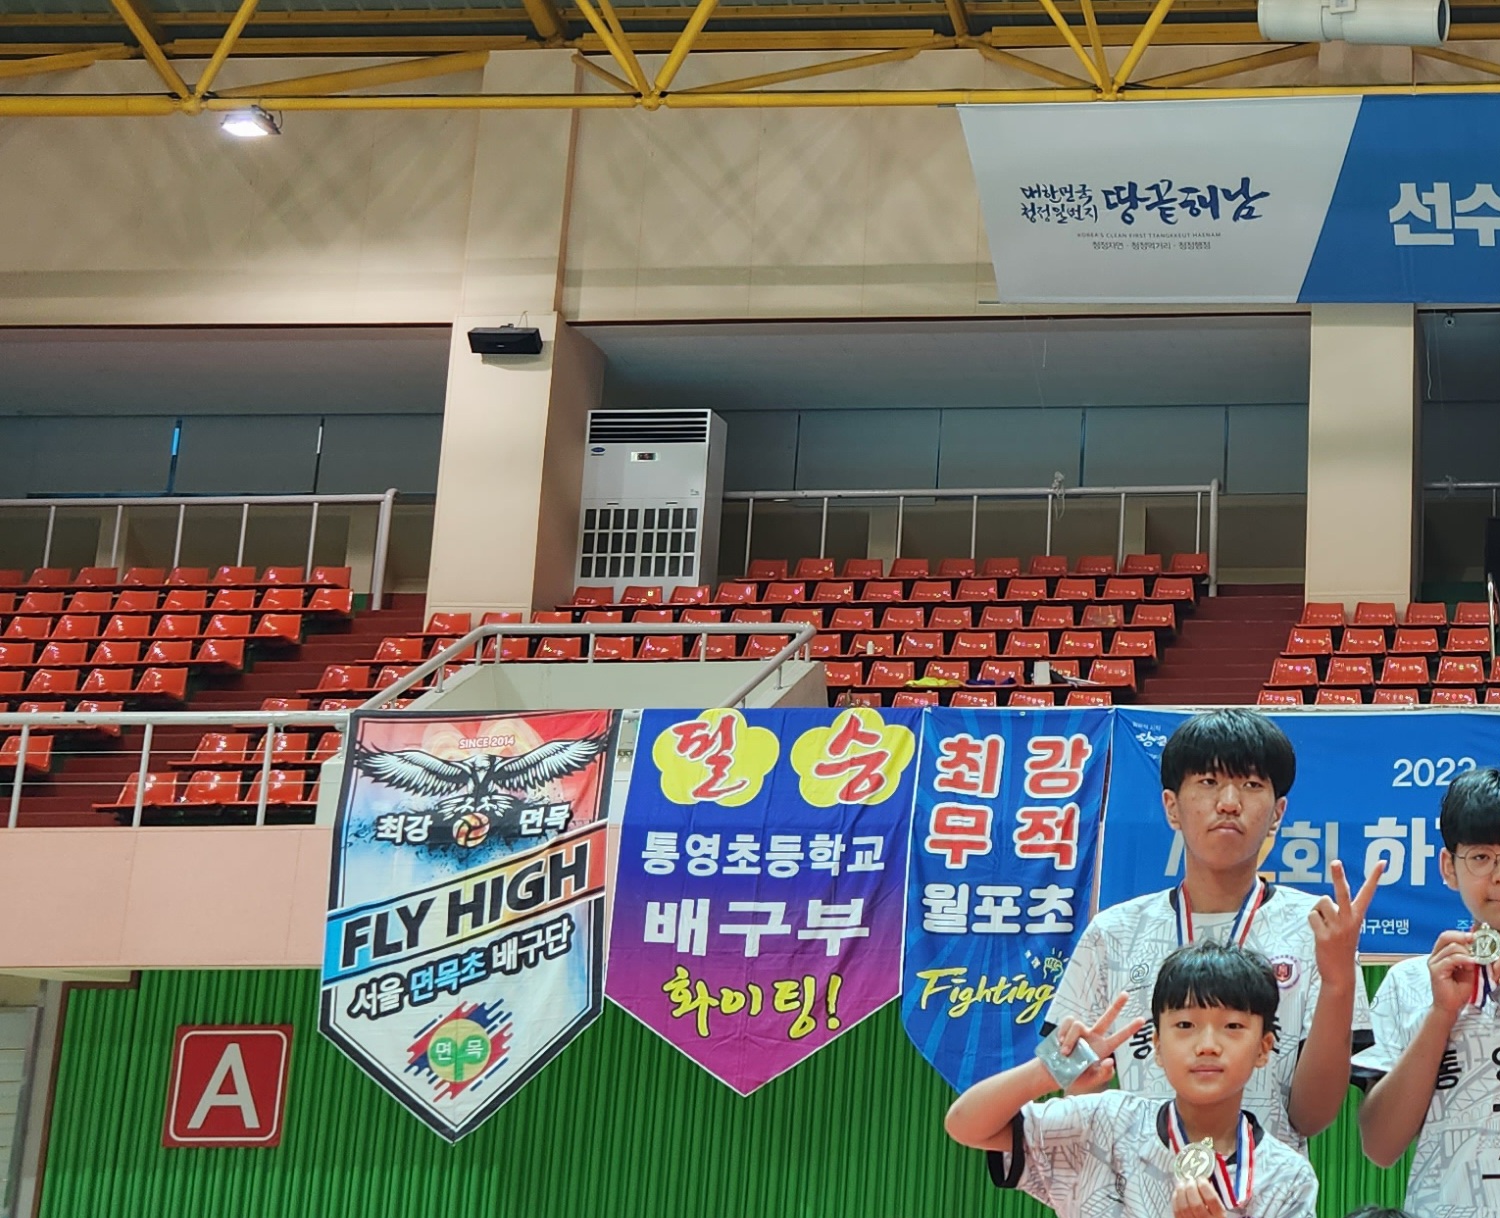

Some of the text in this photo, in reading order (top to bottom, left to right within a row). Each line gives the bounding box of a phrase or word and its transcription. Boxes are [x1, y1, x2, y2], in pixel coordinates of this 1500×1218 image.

[1020, 176, 1270, 225] 대한민국 땅끝해남
[459, 735, 516, 749] SINCE 2014
[376, 804, 571, 845] 최강 면목
[925, 801, 1081, 870] 무적
[641, 830, 886, 878] 통영초등학교
[338, 841, 592, 973] FLY HIGH
[643, 898, 870, 958] 배구부
[922, 882, 1076, 935] 월포초
[349, 919, 572, 1017] 서울 면목초 배구단
[915, 967, 1056, 1024] Fighting
[662, 965, 844, 1038] 화이팅!
[187, 1042, 261, 1129] A
